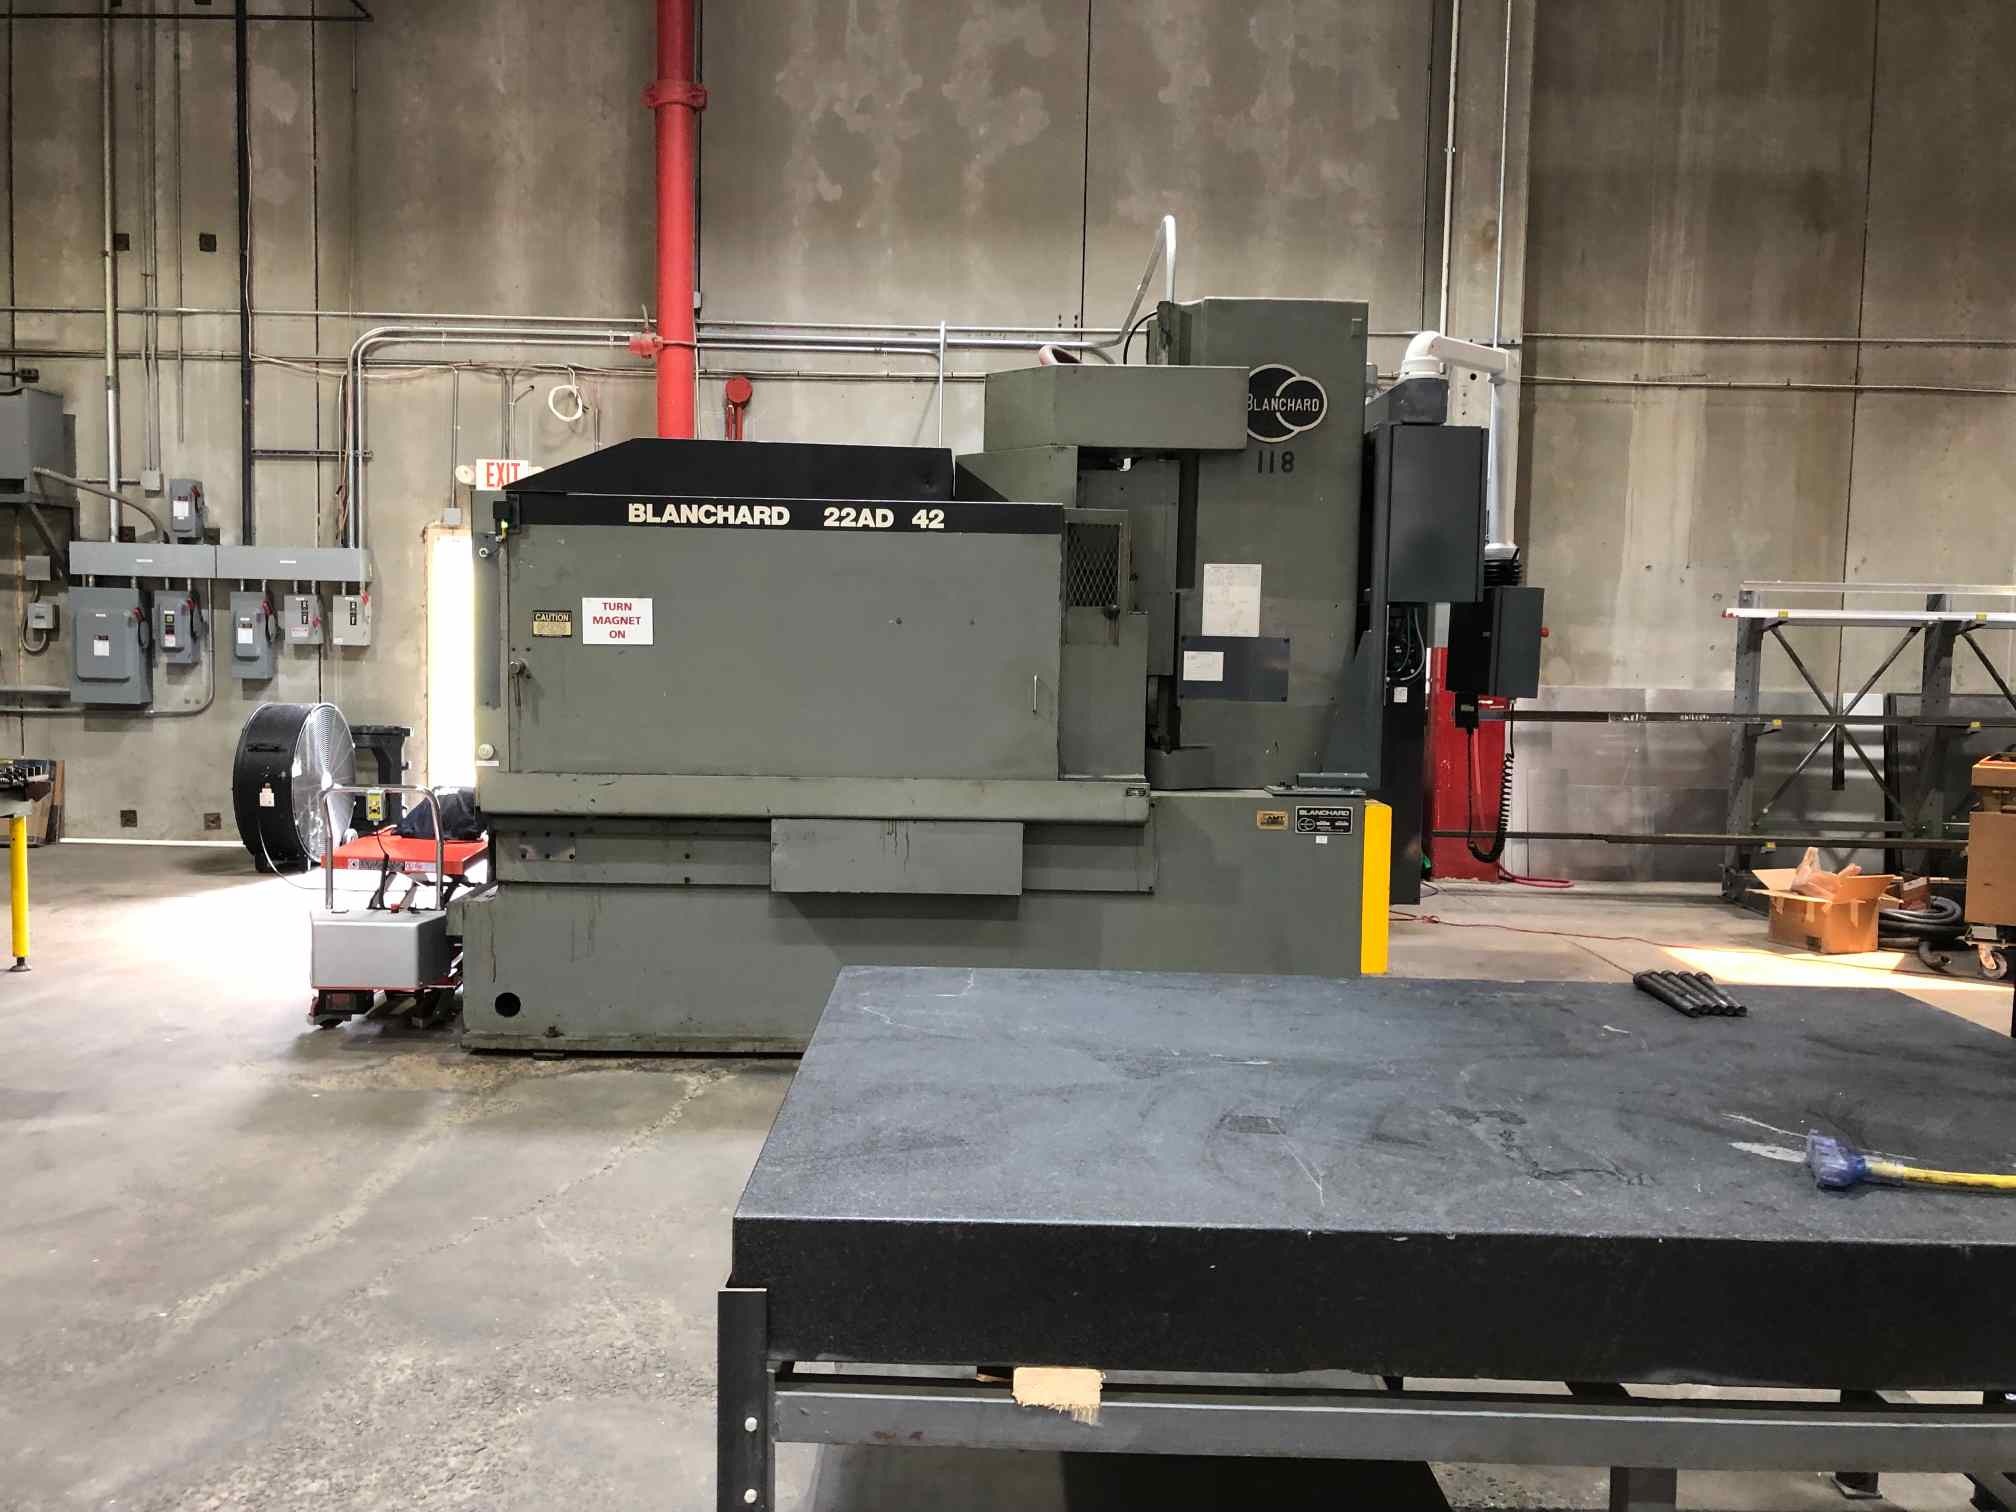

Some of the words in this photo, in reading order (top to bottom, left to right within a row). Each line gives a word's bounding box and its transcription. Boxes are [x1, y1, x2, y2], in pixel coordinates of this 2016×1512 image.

[1247, 394, 1320, 412] BLANCHARD
[1257, 450, 1295, 474] 118
[486, 462, 521, 488] EXIT
[627, 503, 791, 526] BLANCHARD
[823, 507, 895, 528] 22AD
[911, 509, 945, 529] 42
[602, 602, 633, 611] TURN
[535, 613, 569, 622] CAUTION
[592, 616, 641, 625] MAGNET
[609, 630, 626, 639] ON
